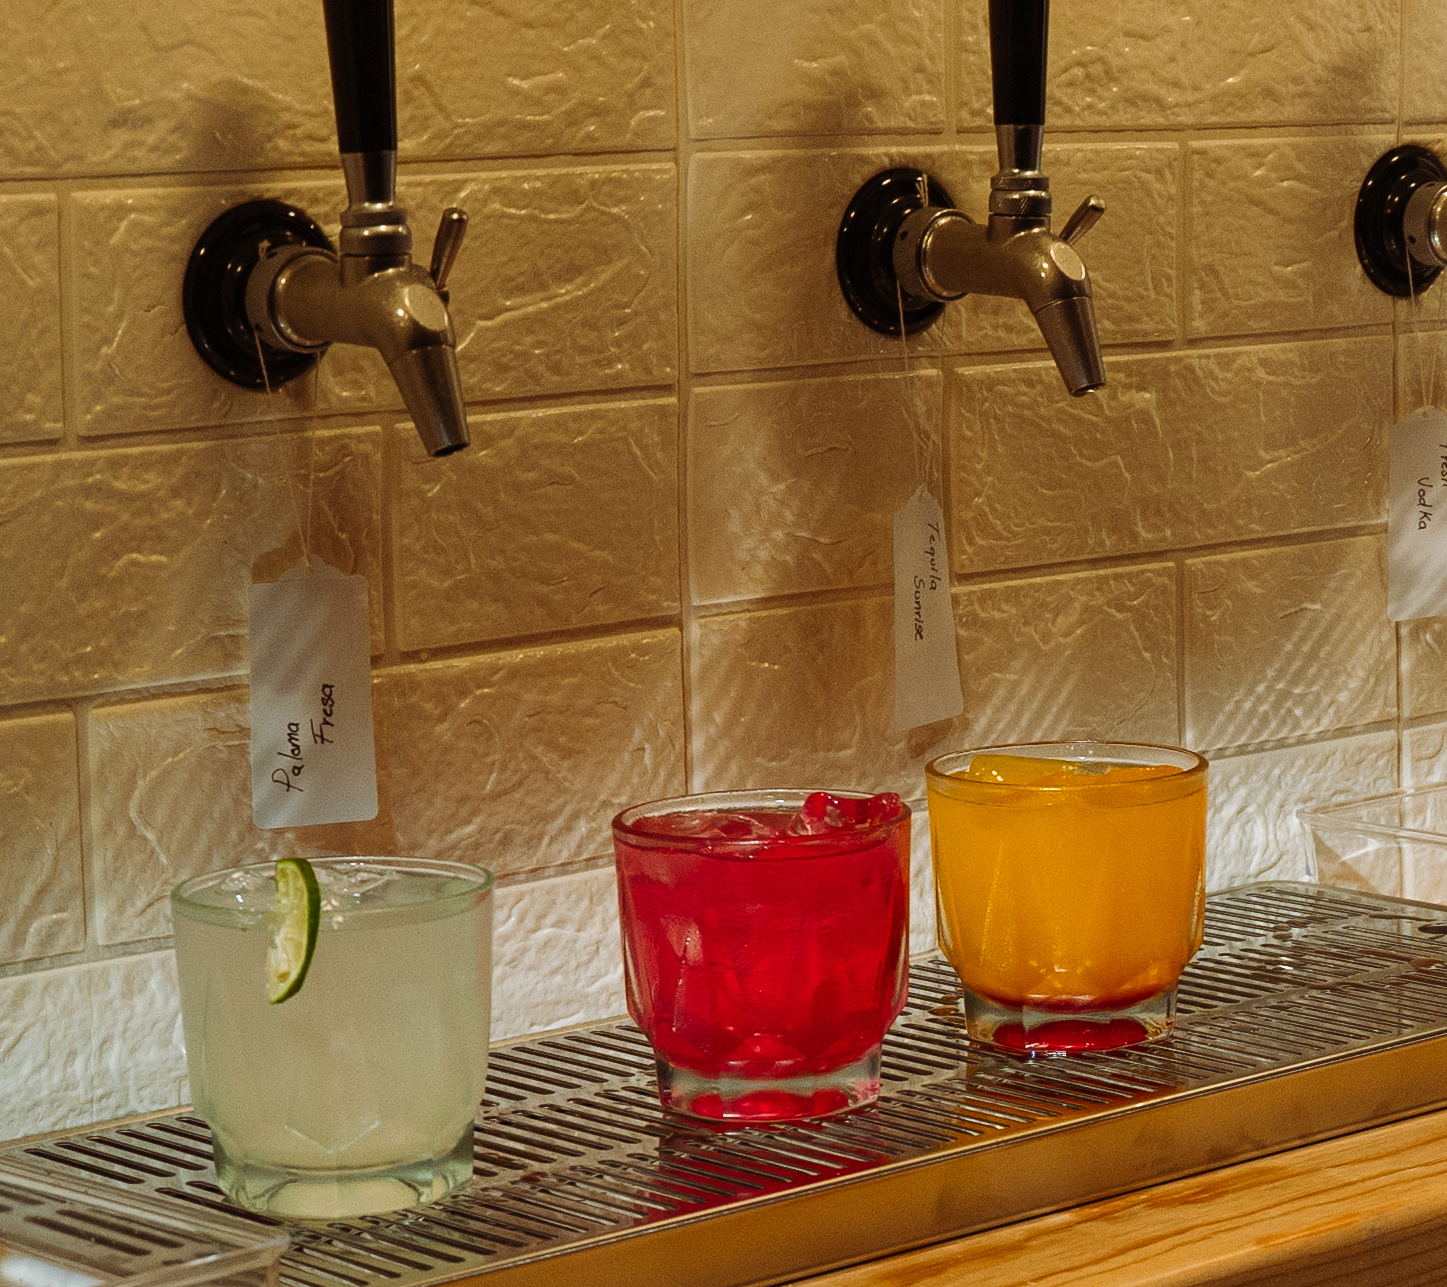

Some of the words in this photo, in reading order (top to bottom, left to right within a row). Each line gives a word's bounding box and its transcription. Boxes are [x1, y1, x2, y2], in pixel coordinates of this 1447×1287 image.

[924, 522, 941, 591] Tequila
[914, 575, 925, 641] Sunrise
[310, 683, 334, 744] Fresa
[272, 722, 303, 792] Paloma
